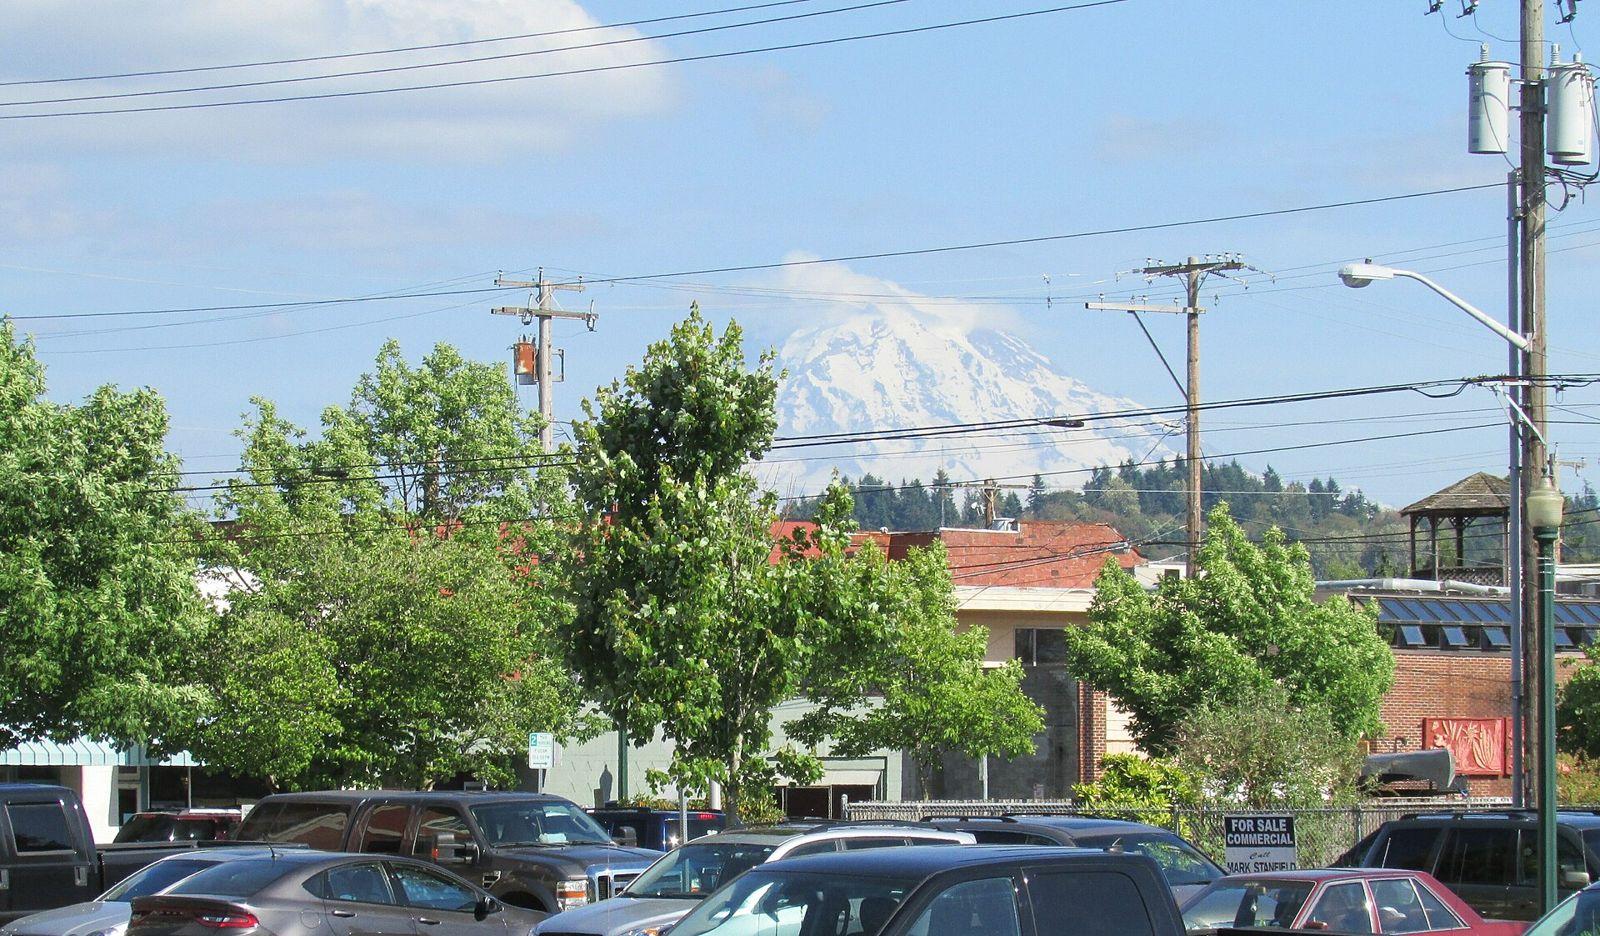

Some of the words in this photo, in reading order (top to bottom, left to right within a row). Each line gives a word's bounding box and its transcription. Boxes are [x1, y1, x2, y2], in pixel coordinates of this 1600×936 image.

[531, 735, 537, 745] 2
[1231, 819, 1255, 832] FOR
[1257, 819, 1287, 832] SALE
[1227, 833, 1294, 845] COMMERCIAL
[1249, 851, 1271, 860] Call
[1227, 862, 1251, 873] MARK
[1253, 861, 1297, 872] STANFIELD
